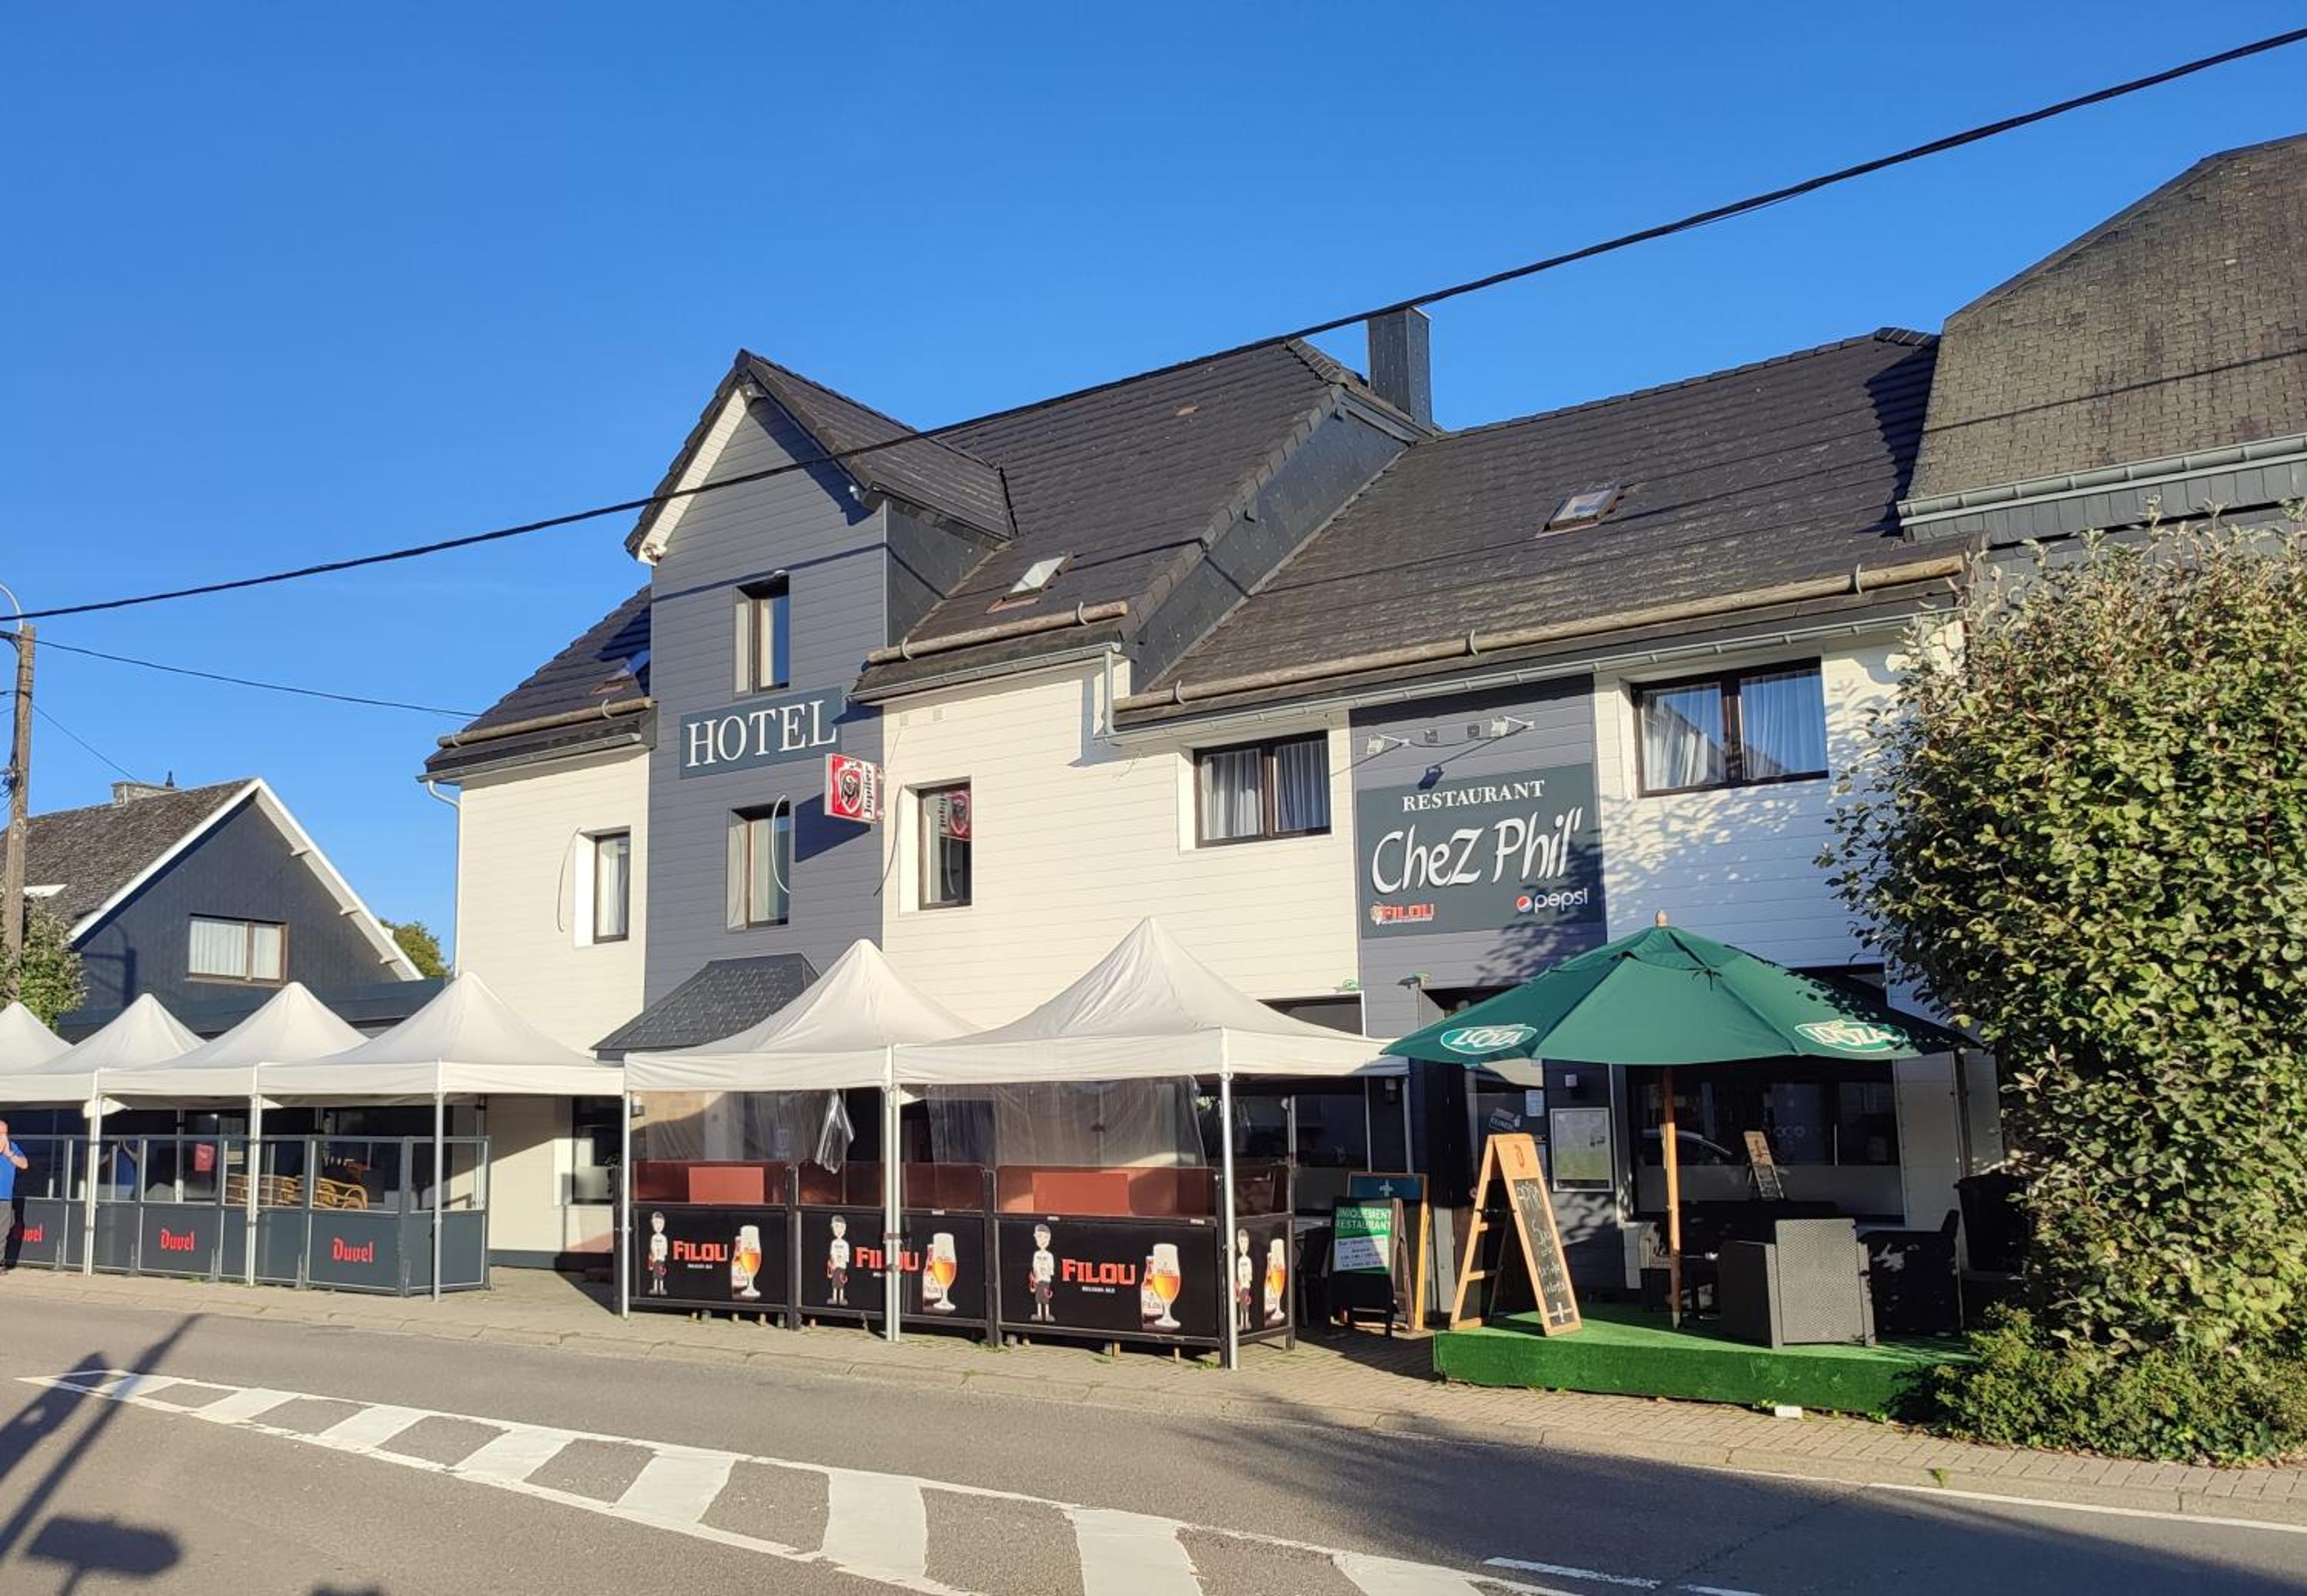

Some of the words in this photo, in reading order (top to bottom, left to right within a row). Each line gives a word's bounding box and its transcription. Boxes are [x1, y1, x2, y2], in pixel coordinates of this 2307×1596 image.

[686, 700, 837, 767] HOTEL
[862, 764, 874, 817] Jupiler
[1402, 780, 1545, 813] RESTAURANT
[1378, 903, 1434, 919] FILOU
[1534, 888, 1588, 915] pepsi
[1450, 1029, 1524, 1047] LOOZA
[161, 1229, 195, 1252] Duvel
[333, 1236, 374, 1264] Duvel
[673, 1240, 728, 1262] FILOU
[1061, 1259, 1136, 1285] FILOU
